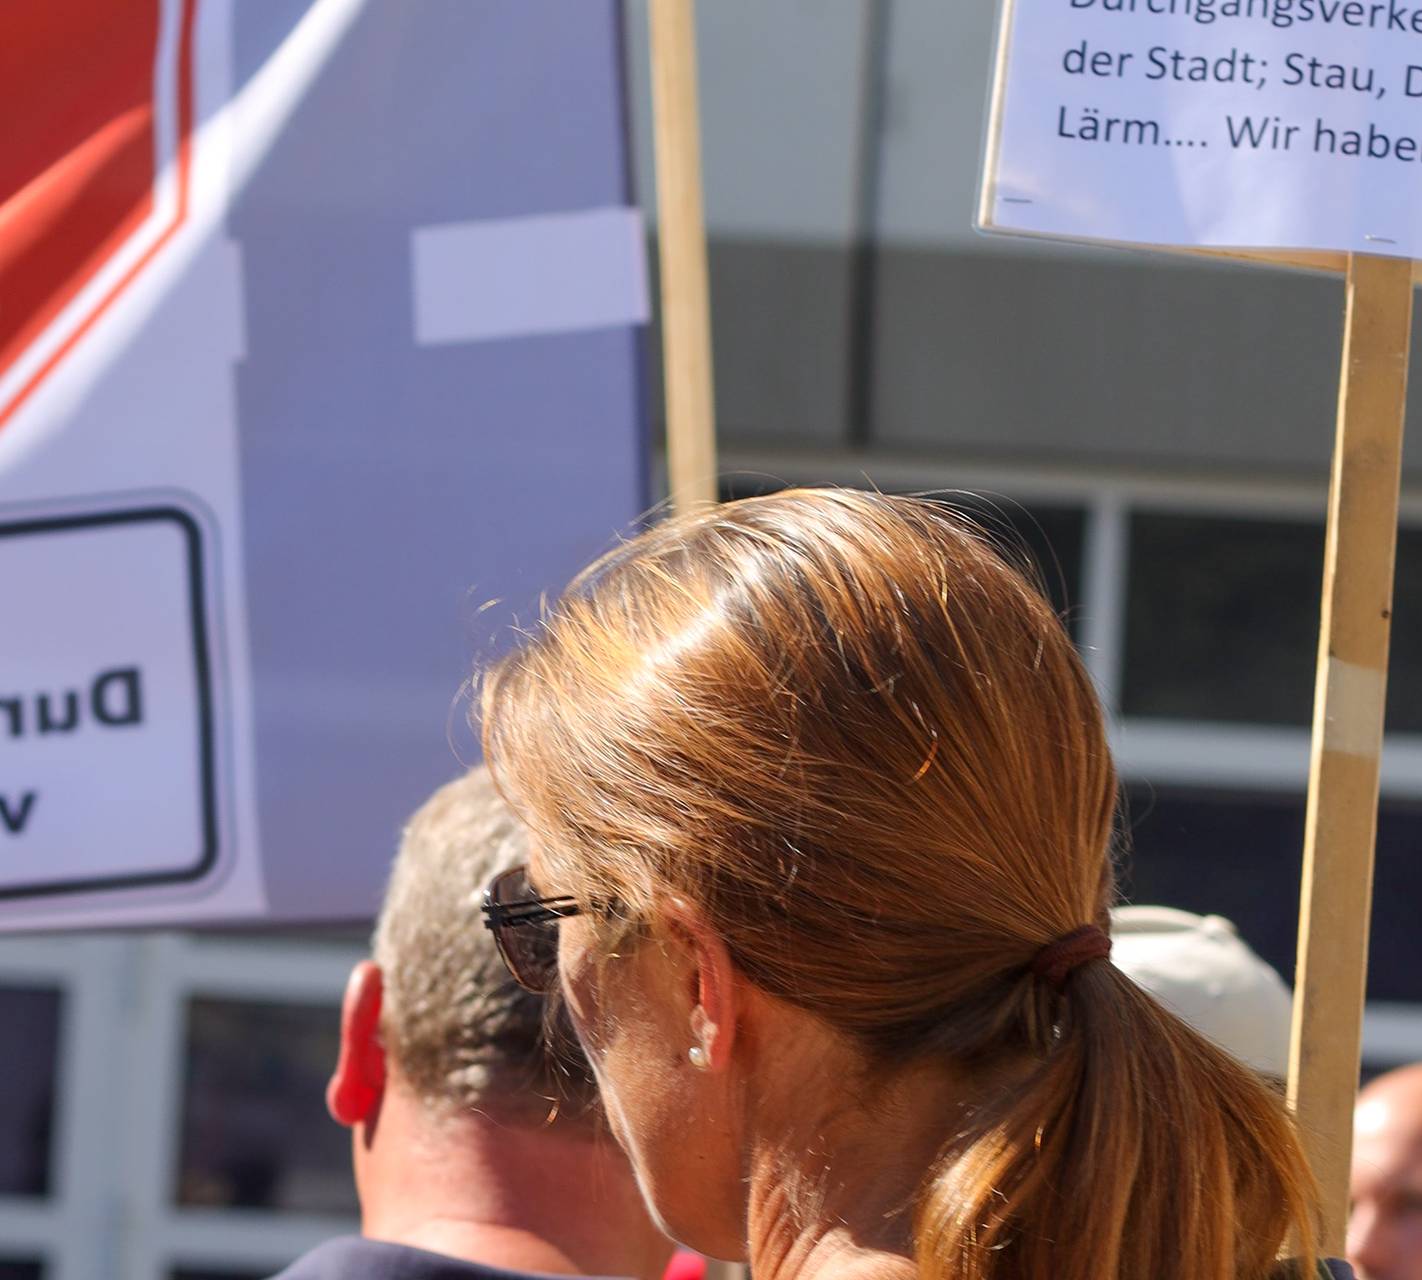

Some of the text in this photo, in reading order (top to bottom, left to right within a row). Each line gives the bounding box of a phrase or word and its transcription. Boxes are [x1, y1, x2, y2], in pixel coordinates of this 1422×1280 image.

[1062, 40, 1133, 78] der
[1145, 46, 1268, 90] Stadt;
[1282, 52, 1386, 100] Stau,
[1057, 106, 1207, 147] Lärm....
[1226, 115, 1300, 150] Wir
